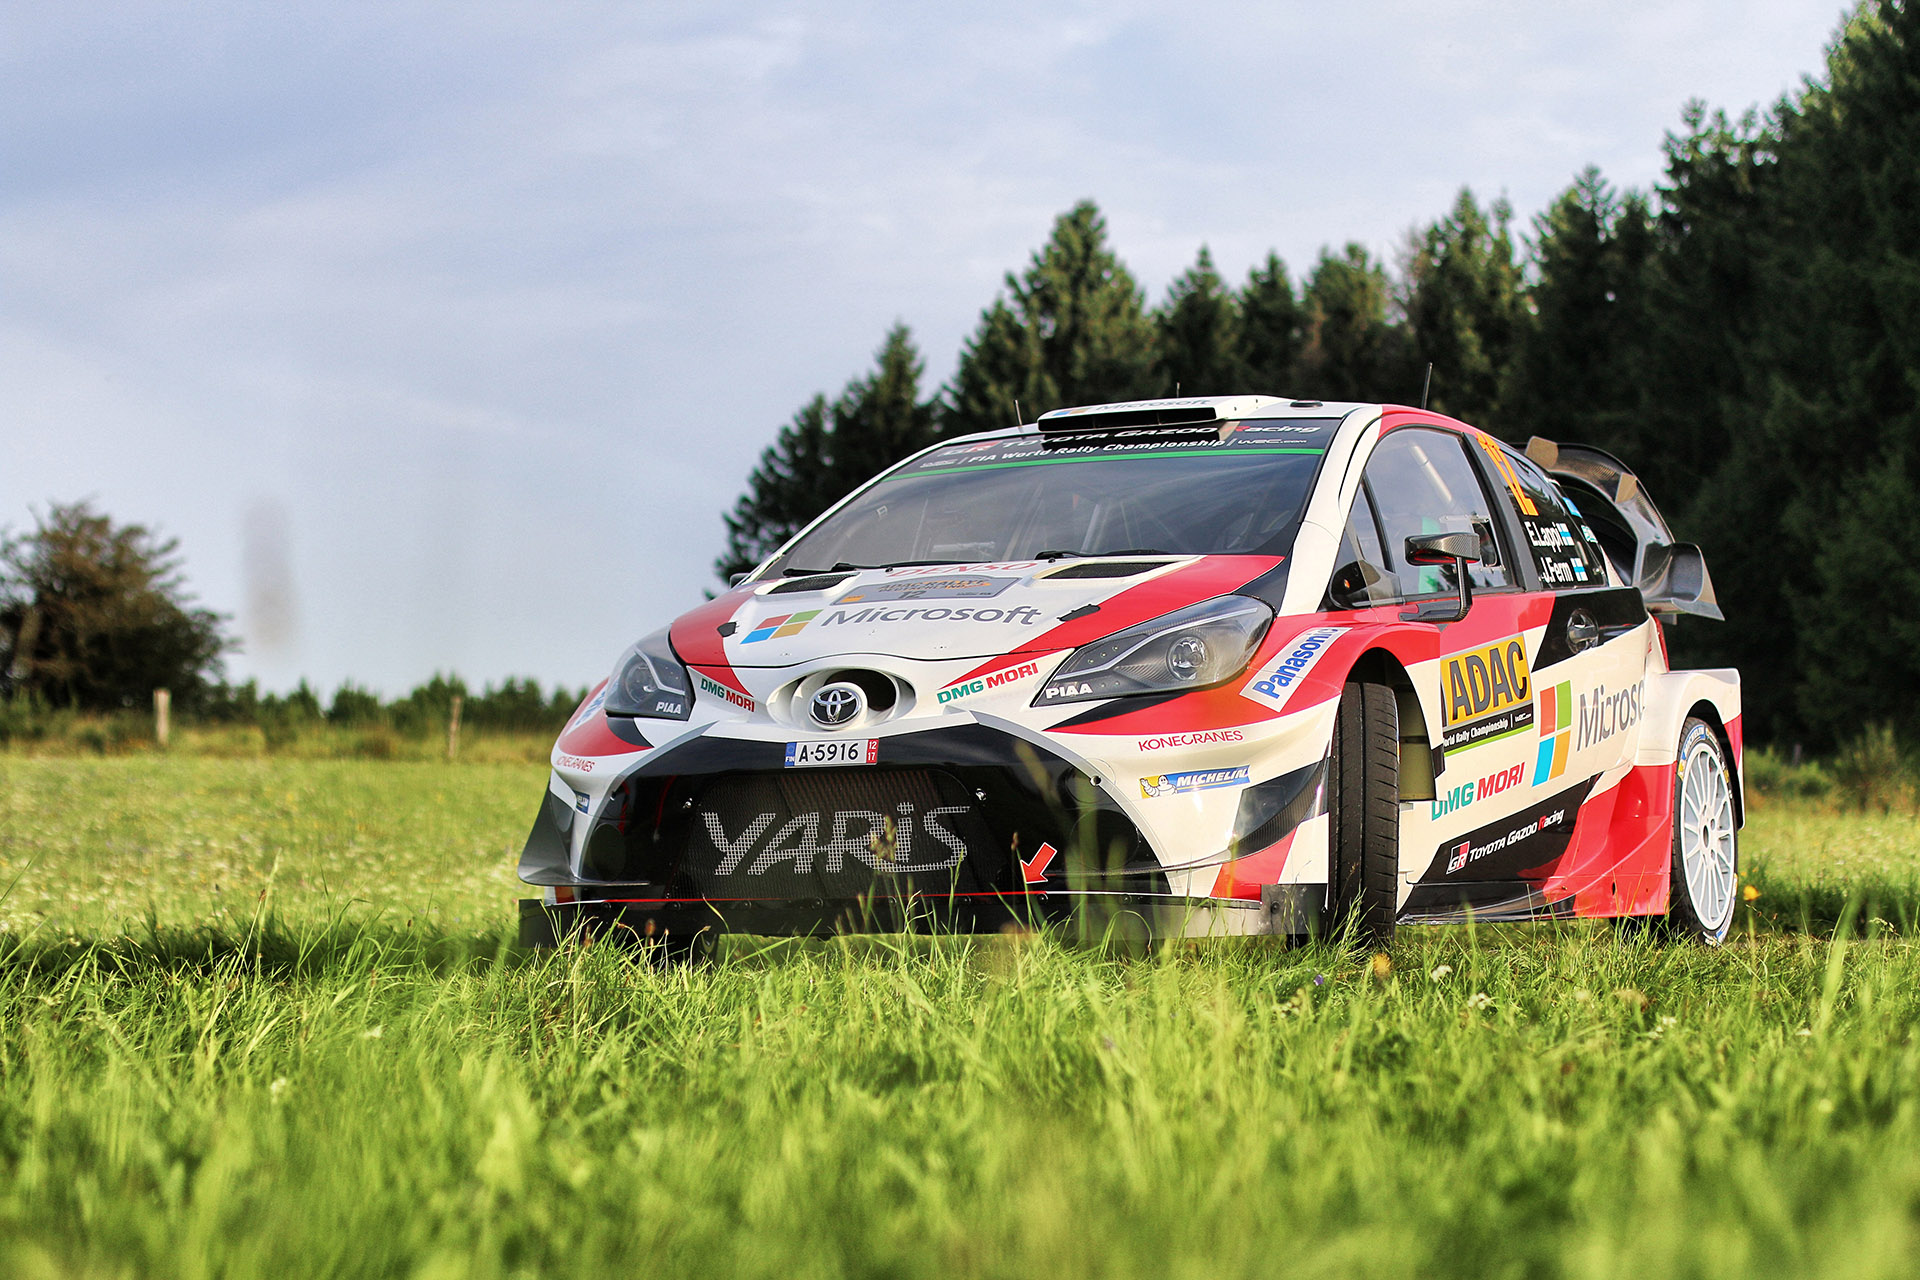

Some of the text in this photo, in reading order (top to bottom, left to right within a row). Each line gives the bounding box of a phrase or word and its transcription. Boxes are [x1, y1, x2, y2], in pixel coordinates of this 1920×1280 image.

[1096, 398, 1213, 412] Microsoft
[968, 453, 996, 463] FIA
[1002, 448, 1052, 461] World
[1053, 443, 1101, 456] Rally
[1103, 437, 1226, 452] Championship
[1002, 432, 1108, 449] TOYOTA
[886, 563, 1038, 577] DENSO
[897, 590, 928, 599] 12
[821, 605, 1042, 627] Microsoft
[1252, 628, 1339, 699] Panasonic
[937, 662, 1039, 704] DMG MORI
[1046, 683, 1093, 699] PIAA
[1451, 640, 1528, 722] ADAC
[700, 678, 755, 712] DMG MORI
[656, 701, 682, 714] PIAA
[868, 741, 877, 750] 12
[1138, 730, 1243, 752] KONECRANES
[867, 752, 876, 761] 17
[1176, 767, 1248, 787] MICHELIN
[1476, 761, 1525, 802] MORI
[1469, 837, 1506, 863] TOYOTA
